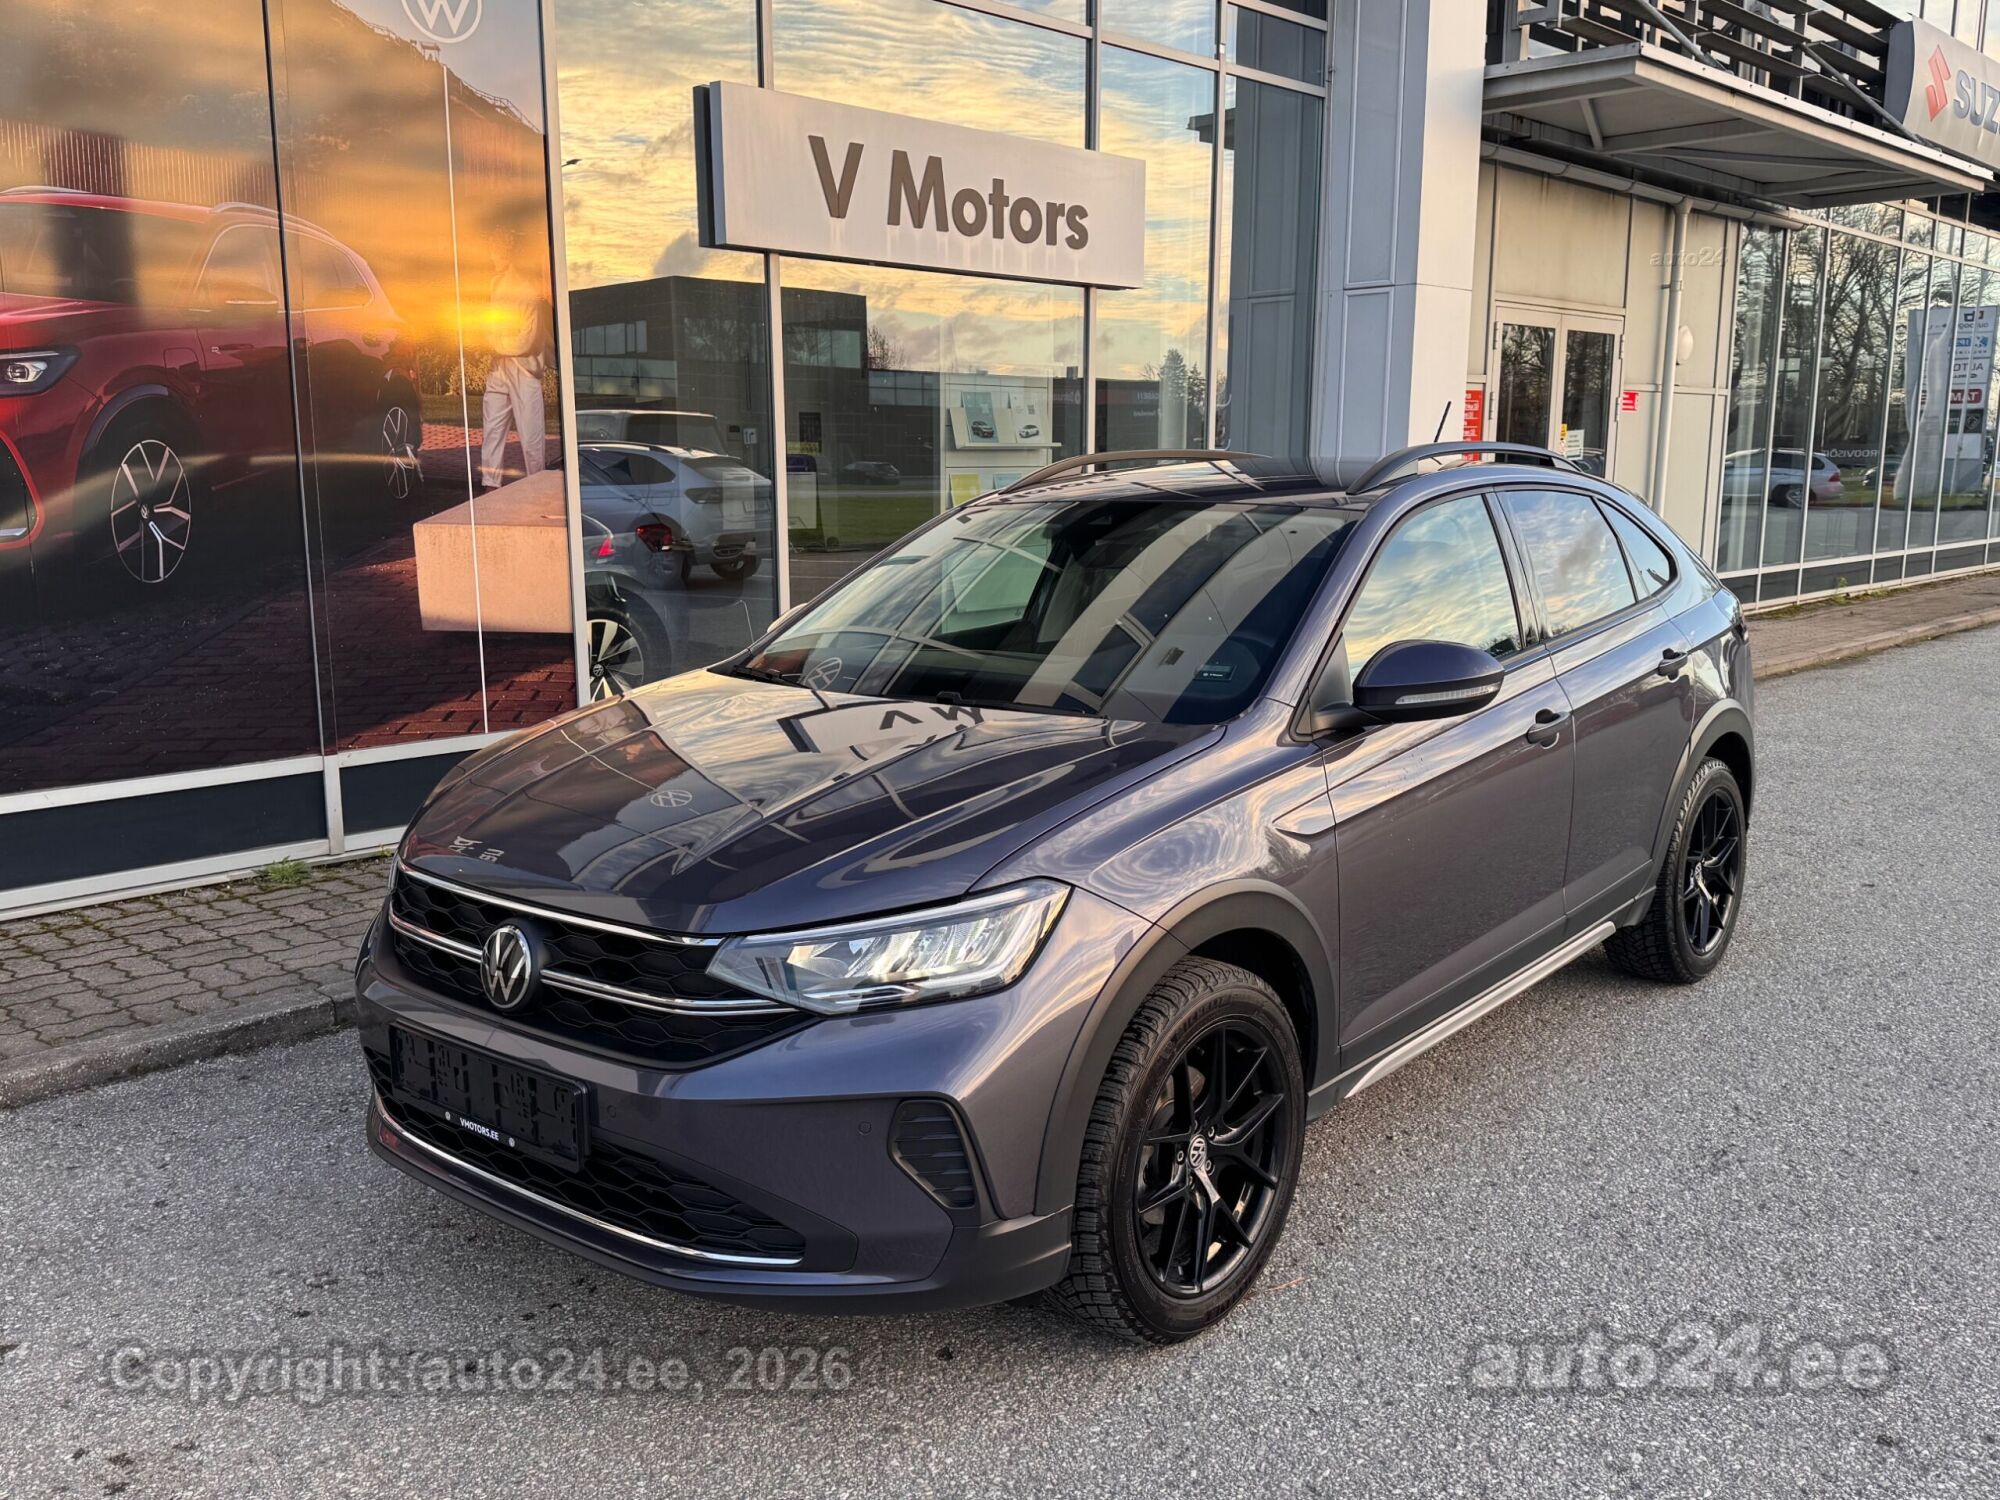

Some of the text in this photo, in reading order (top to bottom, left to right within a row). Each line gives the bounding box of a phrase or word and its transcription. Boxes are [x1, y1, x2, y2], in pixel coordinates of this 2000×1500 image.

[1953, 70, 2000, 135] SUZ
[807, 134, 1089, 250] V Motors
[459, 1117, 500, 1142] VMOTORS.EE
